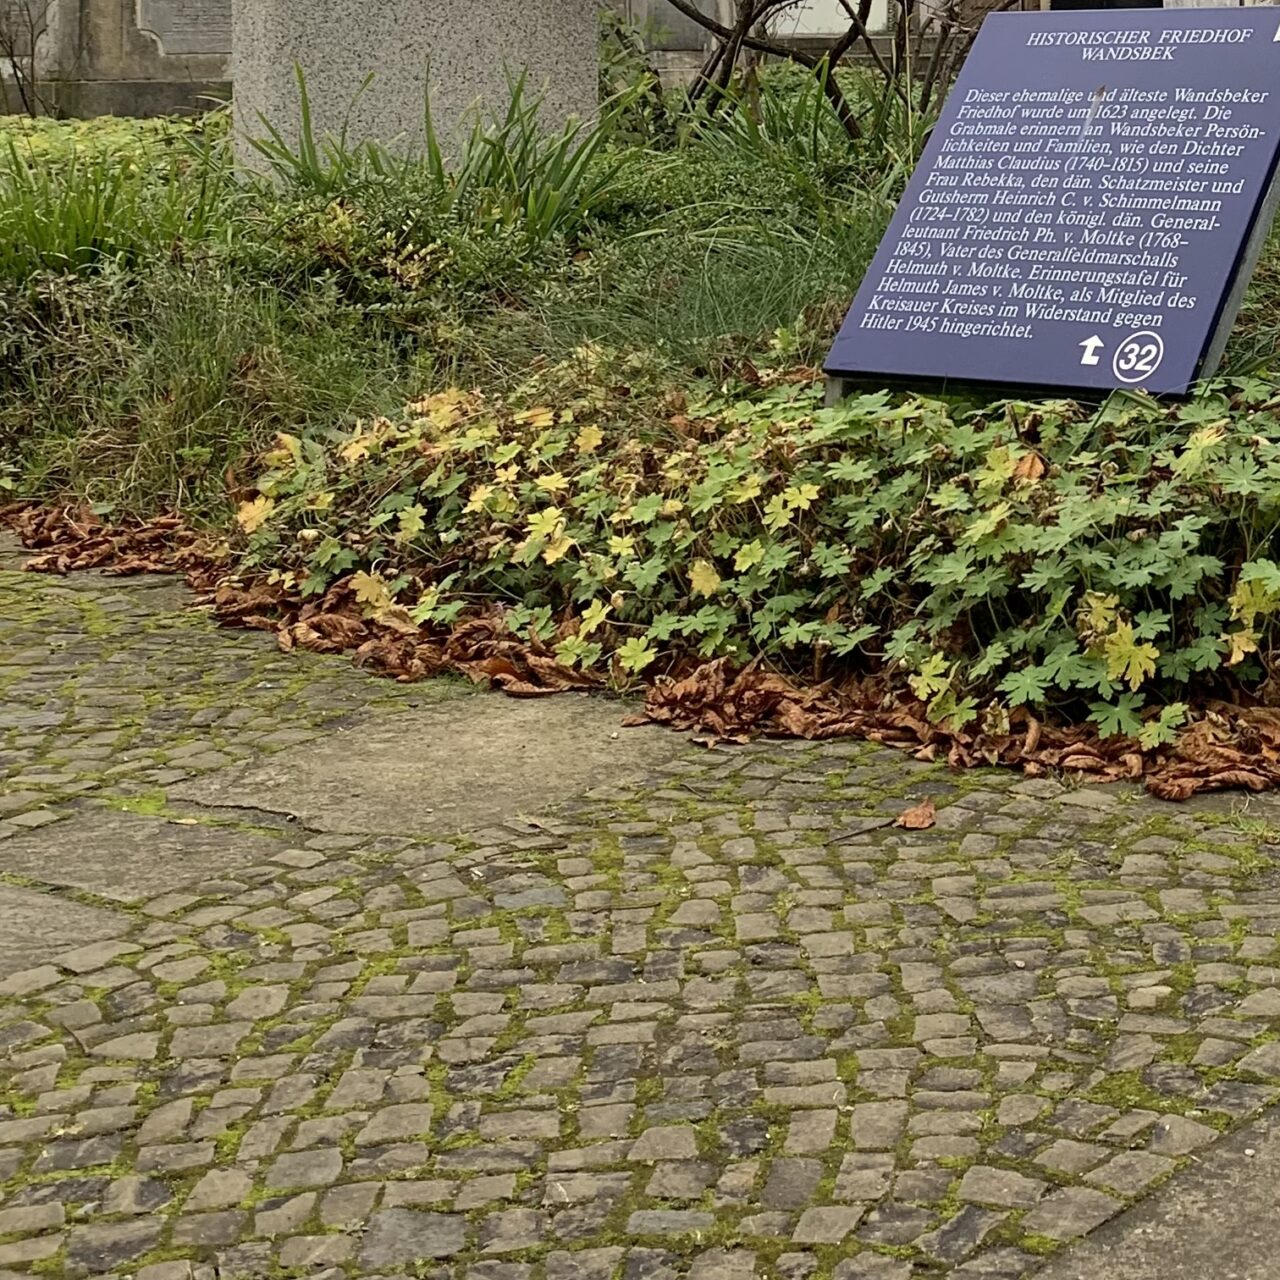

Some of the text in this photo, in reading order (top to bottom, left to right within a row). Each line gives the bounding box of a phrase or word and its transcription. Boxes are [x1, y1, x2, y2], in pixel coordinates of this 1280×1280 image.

[1026, 29, 1253, 45] HISTORISCHER FRIEDHOF
[1082, 46, 1177, 61] WANDSBEK
[964, 89, 1010, 102] Dieser
[1012, 88, 1084, 104] ehemalige
[1119, 88, 1168, 102] älteste
[1175, 88, 1269, 103] Wandsbeker
[956, 104, 1232, 122] Friedhof wurde um 1623 angelegt. Die
[950, 122, 1265, 138] Grabmale erinnern an Wandsbeker Persön-
[941, 138, 1245, 156] lichkeiten und Familien, wie den Dichter
[933, 155, 994, 169] Matthias
[998, 155, 1061, 170] Claudius
[1153, 159, 1185, 173] und
[1186, 162, 1229, 174] seine
[925, 172, 1245, 194] Frau Rebekka, den dän. Schatzmeister und
[919, 189, 1222, 211] Gutsherrn Heinrich C. v. Schimmelmann
[992, 209, 1023, 223] und
[1024, 209, 1052, 224] den
[1056, 210, 1106, 228] königl.
[1112, 212, 1143, 227] dän.
[1151, 213, 1220, 230] General-
[901, 224, 960, 239] leutnant
[962, 225, 1030, 241] Friedrich
[1033, 227, 1056, 243] Ph.
[1064, 232, 1073, 243] v.
[1079, 229, 1135, 246] Moltke
[893, 241, 1179, 268] 1845), Vater des Generalfeldmarschalls
[885, 259, 1188, 288] Helmuth v. Moltke. Erinnerungstafel für
[876, 277, 1196, 309] Helmuth James v. Moltke, als Mitglied des
[867, 295, 1163, 328] Kreisauer Kreises im Widerstand gegen
[859, 313, 1033, 338] Hitler 1945 hingerichtet.
[1119, 343, 1157, 370] 32
